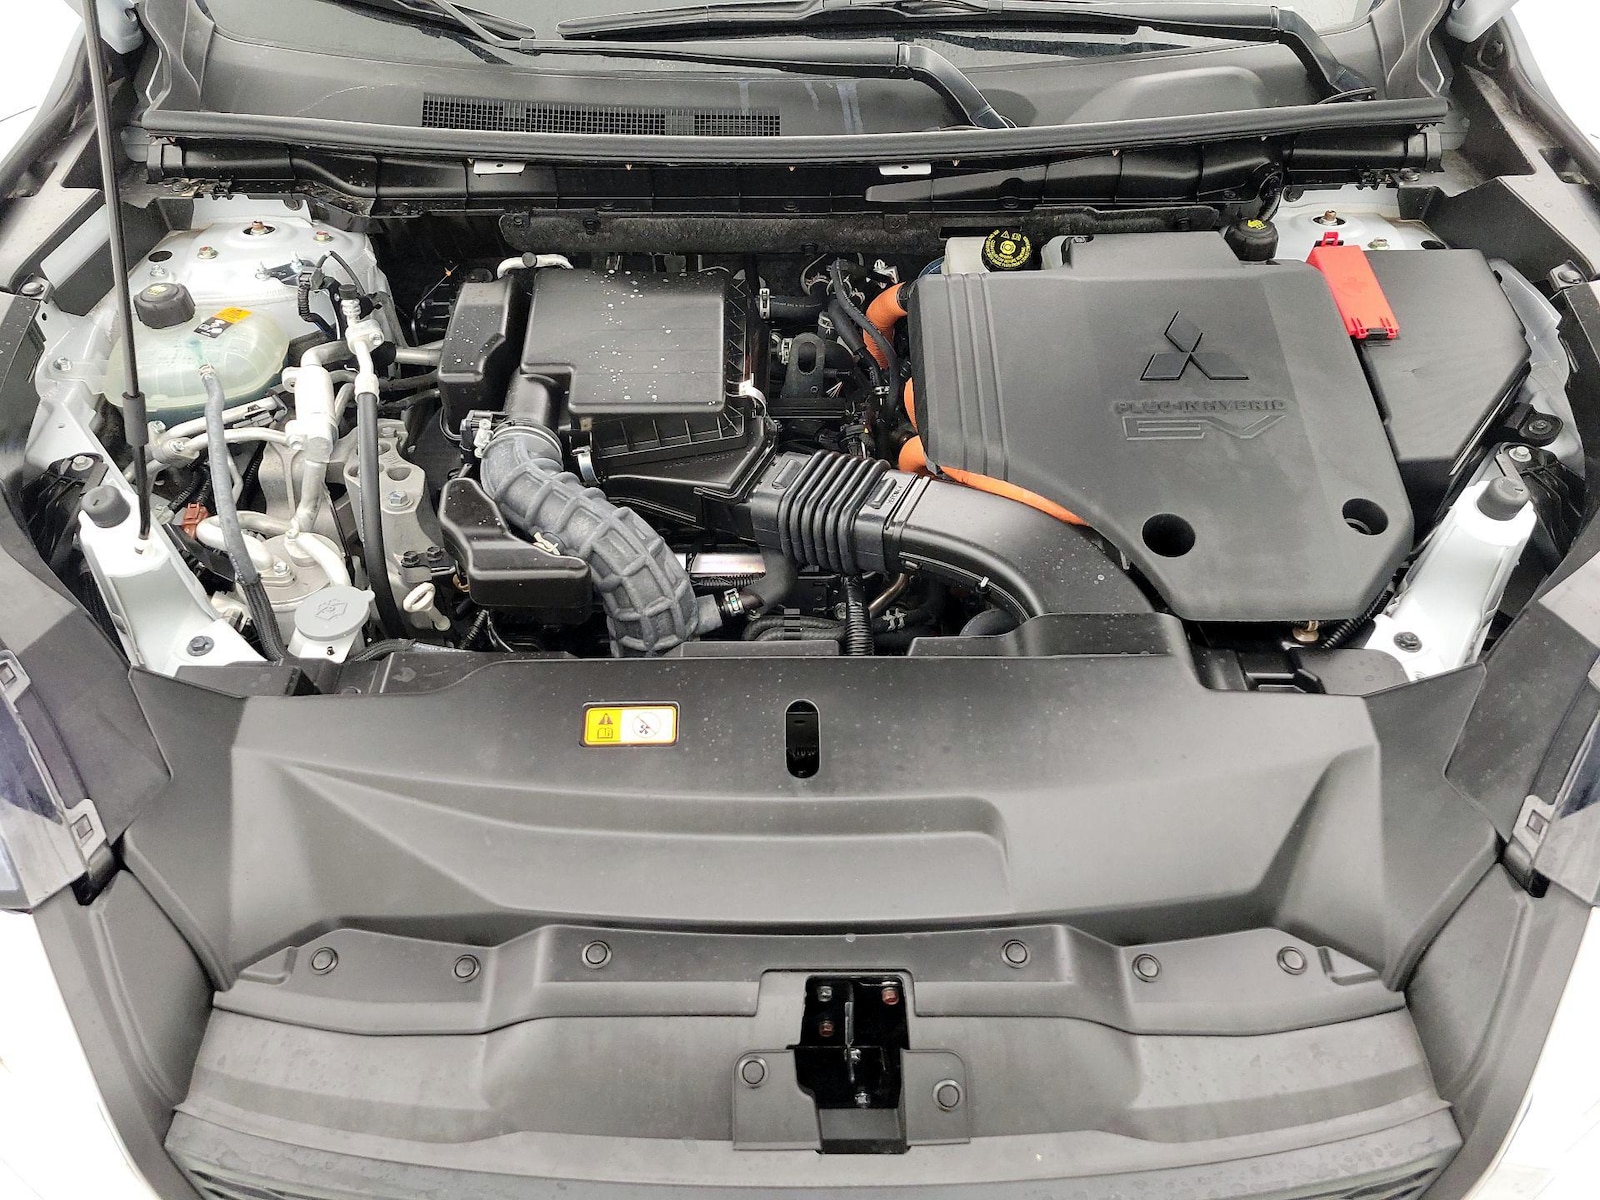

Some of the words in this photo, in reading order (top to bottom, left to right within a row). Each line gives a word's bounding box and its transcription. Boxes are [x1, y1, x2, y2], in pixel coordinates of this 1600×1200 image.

[1115, 400, 1200, 414] PLUG-IN
[1203, 400, 1286, 413] HYBRID
[1122, 415, 1287, 440] EV
